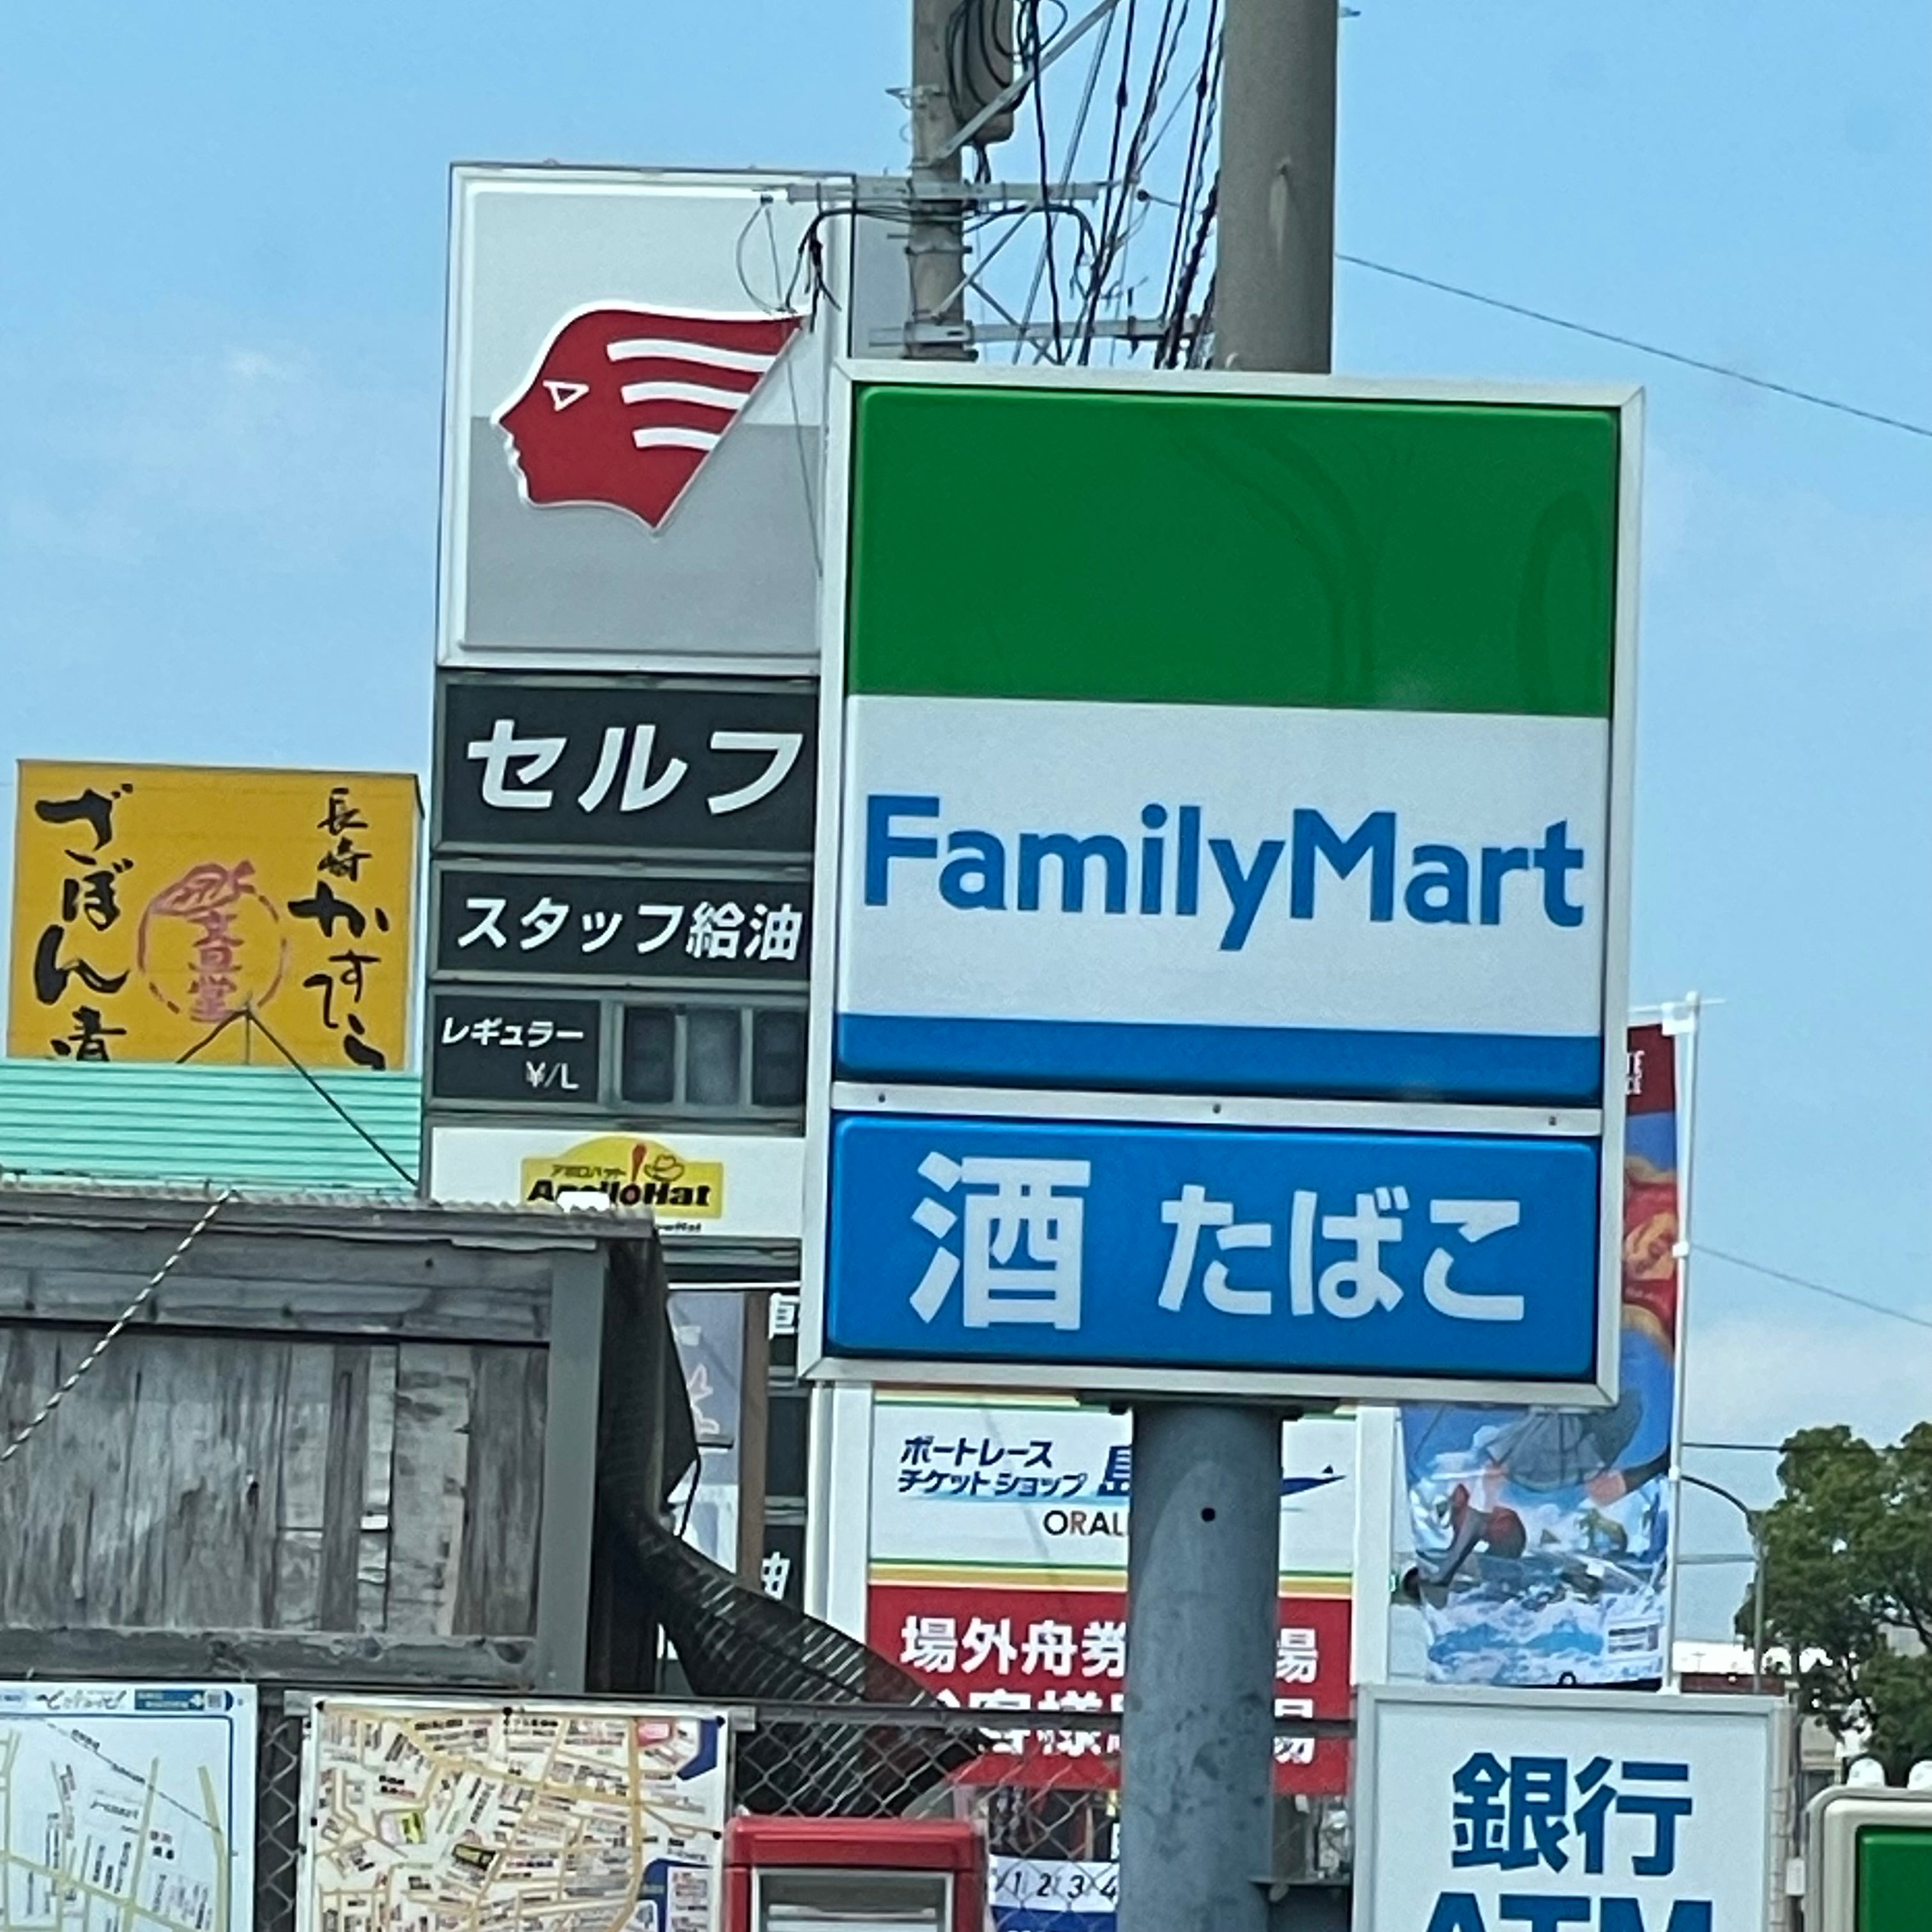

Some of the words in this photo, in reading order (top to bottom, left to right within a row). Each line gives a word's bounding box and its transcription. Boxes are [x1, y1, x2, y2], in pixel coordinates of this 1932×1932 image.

[467, 719, 804, 815] セルフ
[863, 794, 1585, 951] FamilyMart
[457, 897, 803, 961] スタッフ給油
[441, 1017, 585, 1048] レギュラー
[909, 1151, 1091, 1331] 酒
[1157, 1184, 1524, 1321] たばこ
[898, 1469, 1088, 1497] チケットショップ
[1043, 1510, 1124, 1536] ORAL
[1452, 1752, 1693, 1876] 銀行
